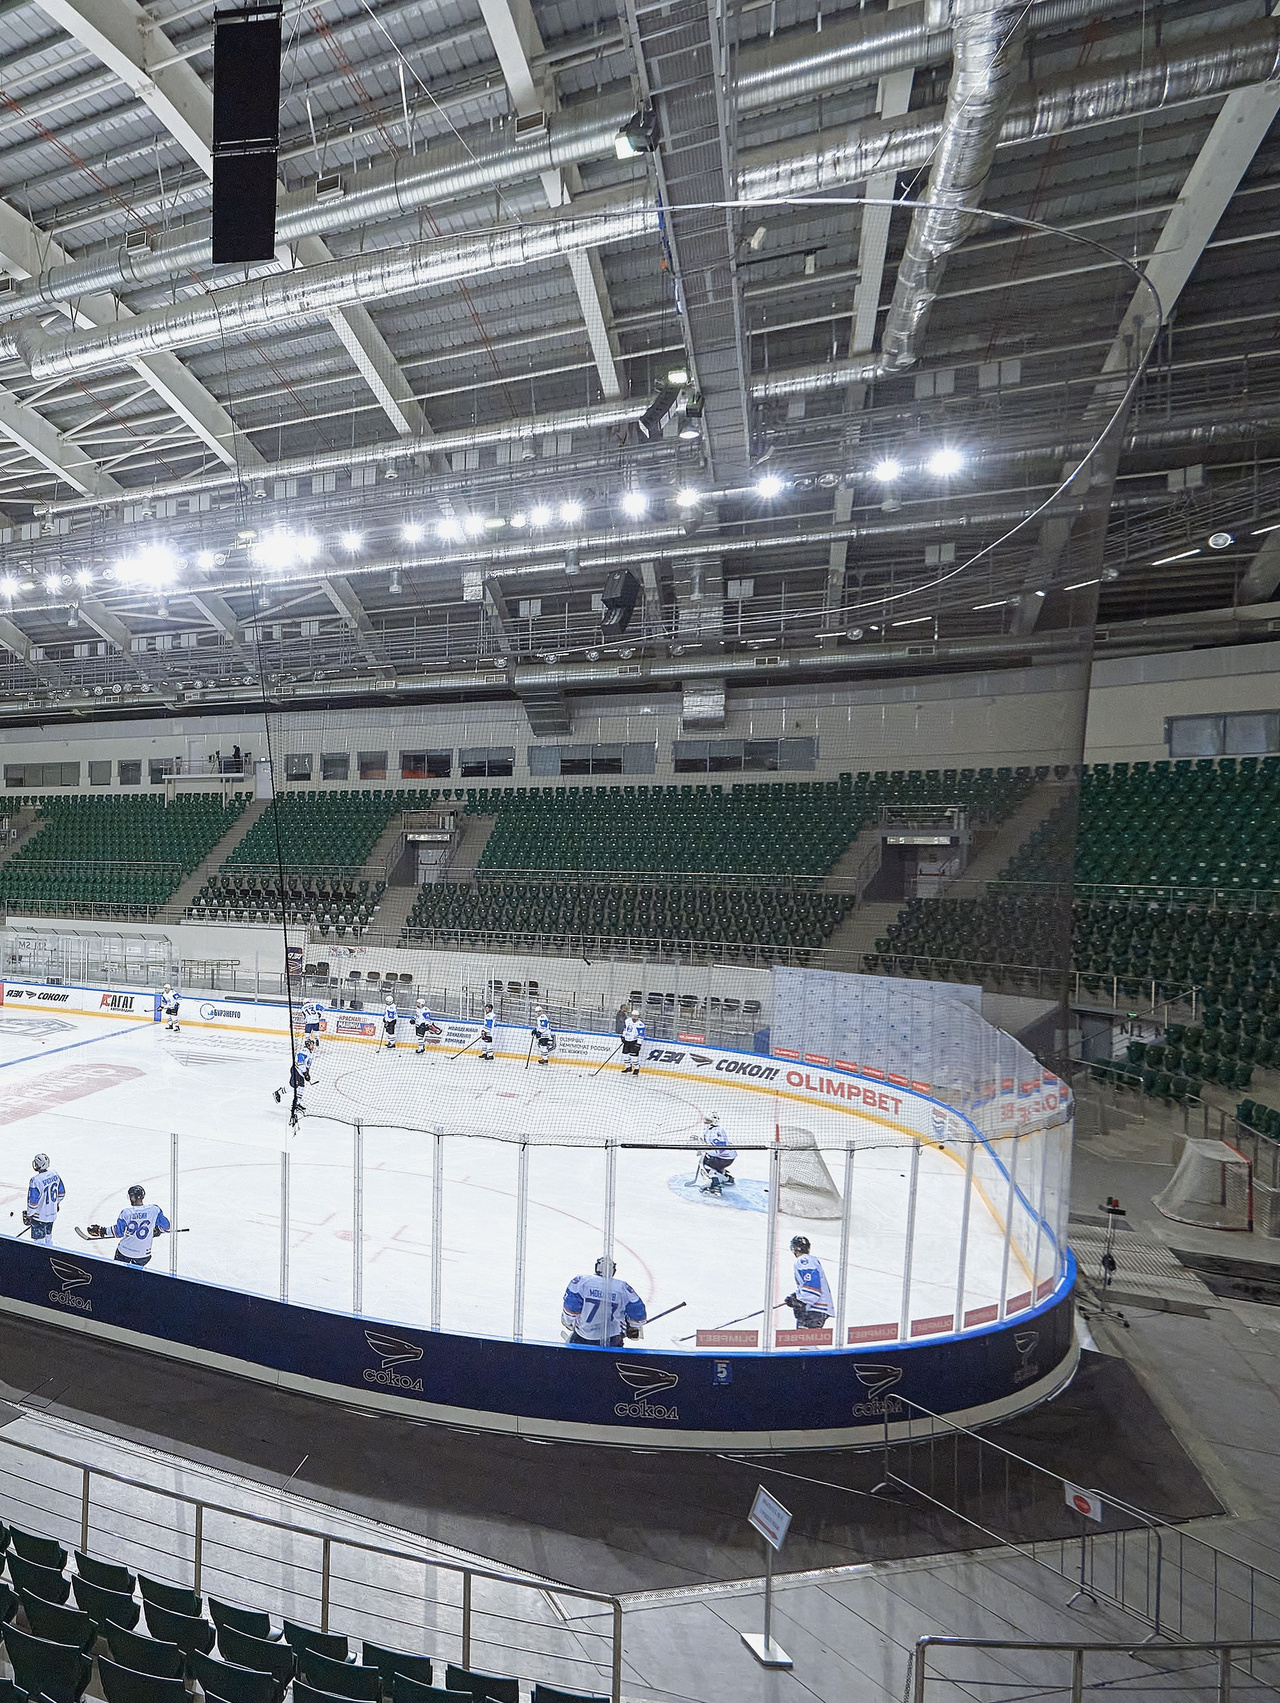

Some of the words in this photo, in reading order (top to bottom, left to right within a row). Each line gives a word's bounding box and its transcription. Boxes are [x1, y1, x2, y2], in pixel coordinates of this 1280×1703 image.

[37, 992, 70, 1003] СОКОЛ!
[110, 996, 135, 1008] АГАТ
[714, 1058, 780, 1081] СОКОЛ!
[786, 1070, 903, 1115] OLIMPBET
[43, 1183, 59, 1205] 16
[126, 1219, 151, 1240] 96
[362, 1366, 424, 1392] сокол
[716, 1363, 727, 1378] 5
[614, 1397, 679, 1420] сокол
